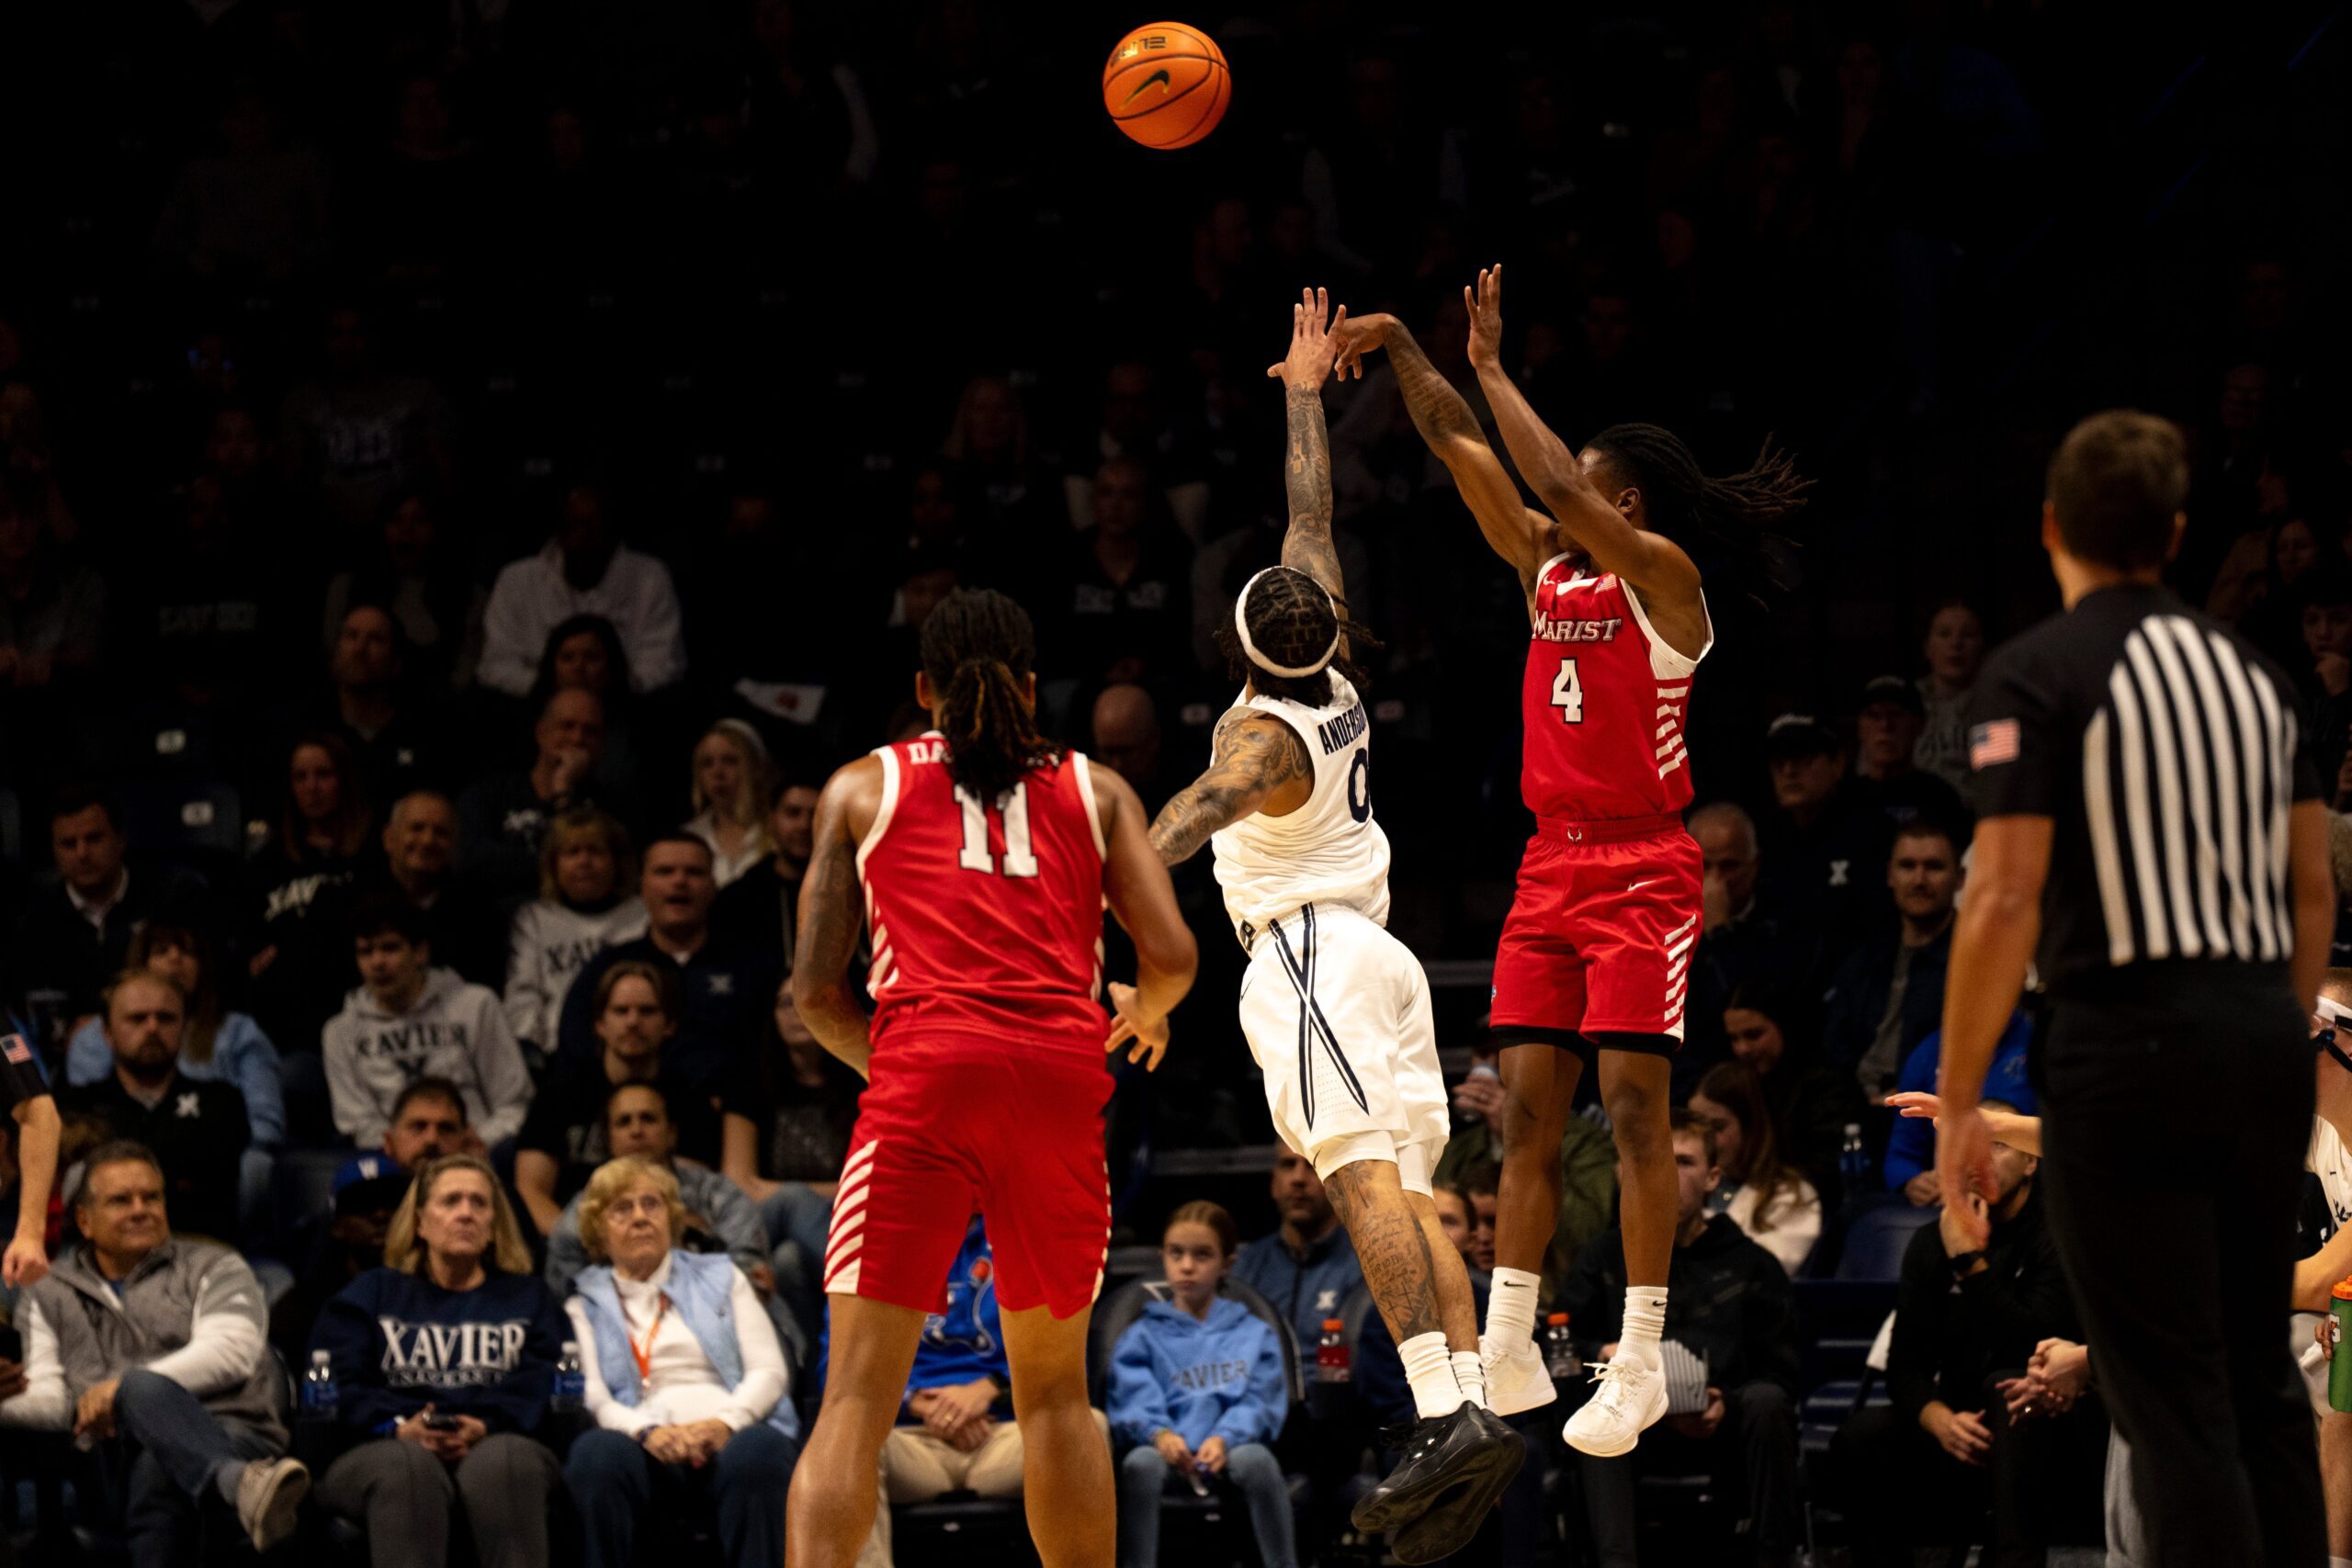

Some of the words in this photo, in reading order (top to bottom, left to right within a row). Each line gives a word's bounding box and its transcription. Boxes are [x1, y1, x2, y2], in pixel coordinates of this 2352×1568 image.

[1550, 659, 1583, 723] 4
[1347, 747, 1370, 824] 0
[954, 781, 1039, 877] 11
[378, 1314, 532, 1372] XAVIER
